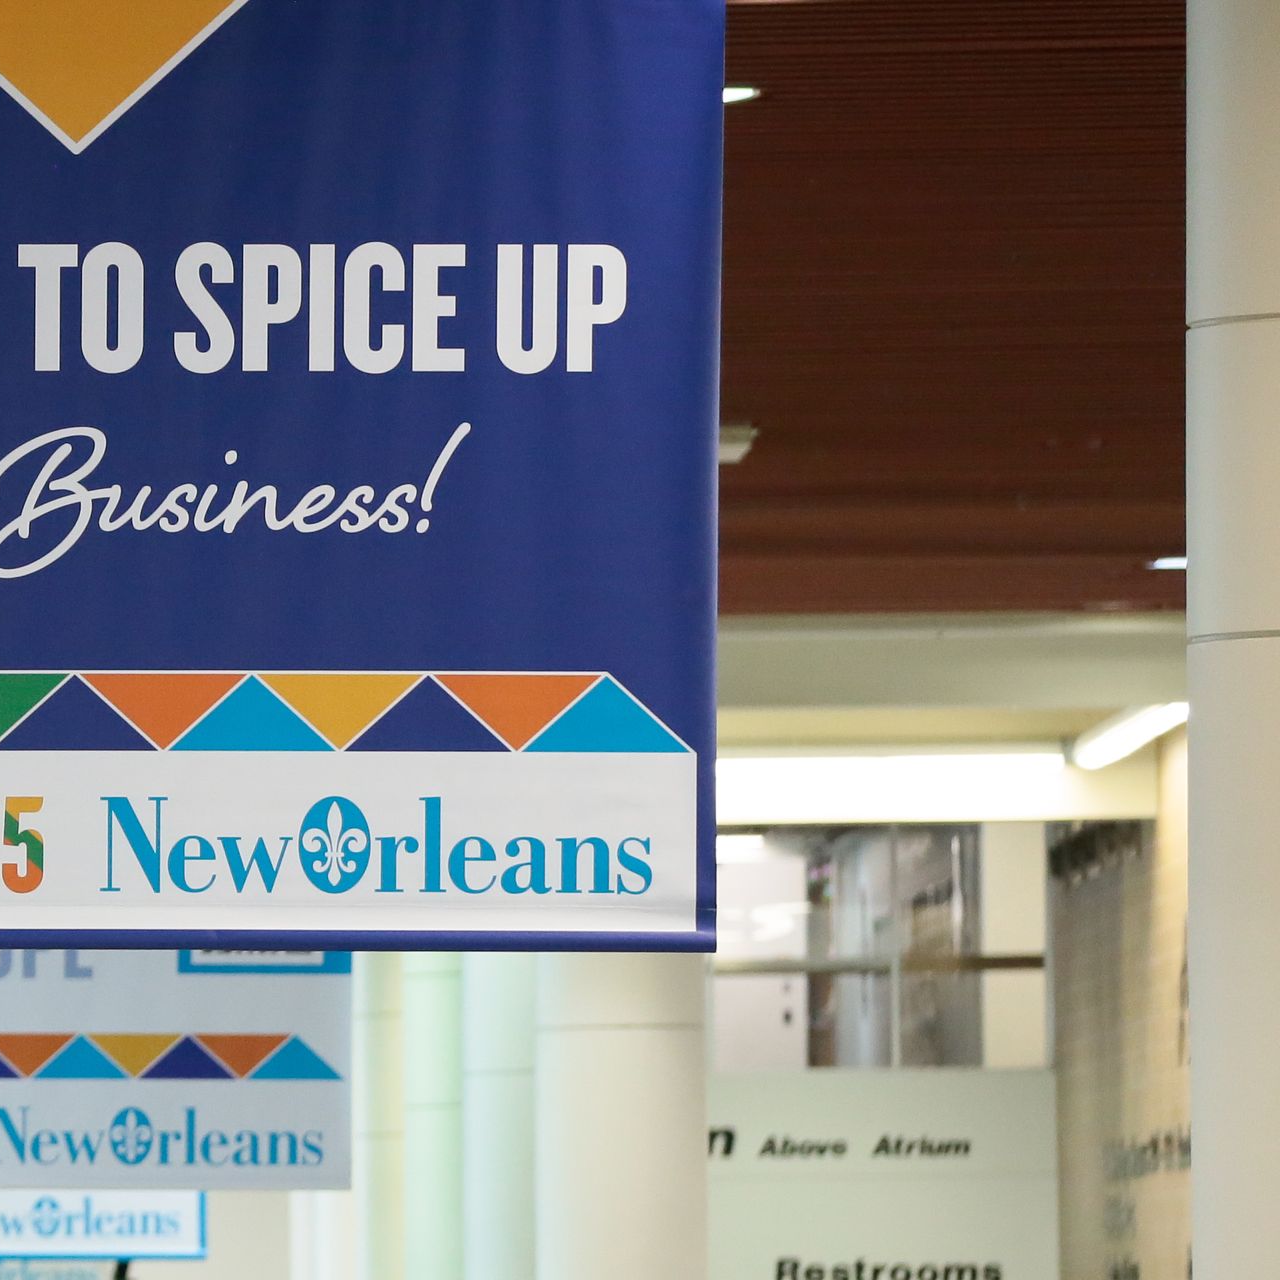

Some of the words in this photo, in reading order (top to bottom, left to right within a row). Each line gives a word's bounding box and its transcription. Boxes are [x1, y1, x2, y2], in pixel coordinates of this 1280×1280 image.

[18, 242, 144, 373] TO
[175, 242, 465, 373] SPICE
[495, 243, 627, 373] UP
[759, 1136, 847, 1158] Above
[873, 1134, 971, 1158] Atrium
